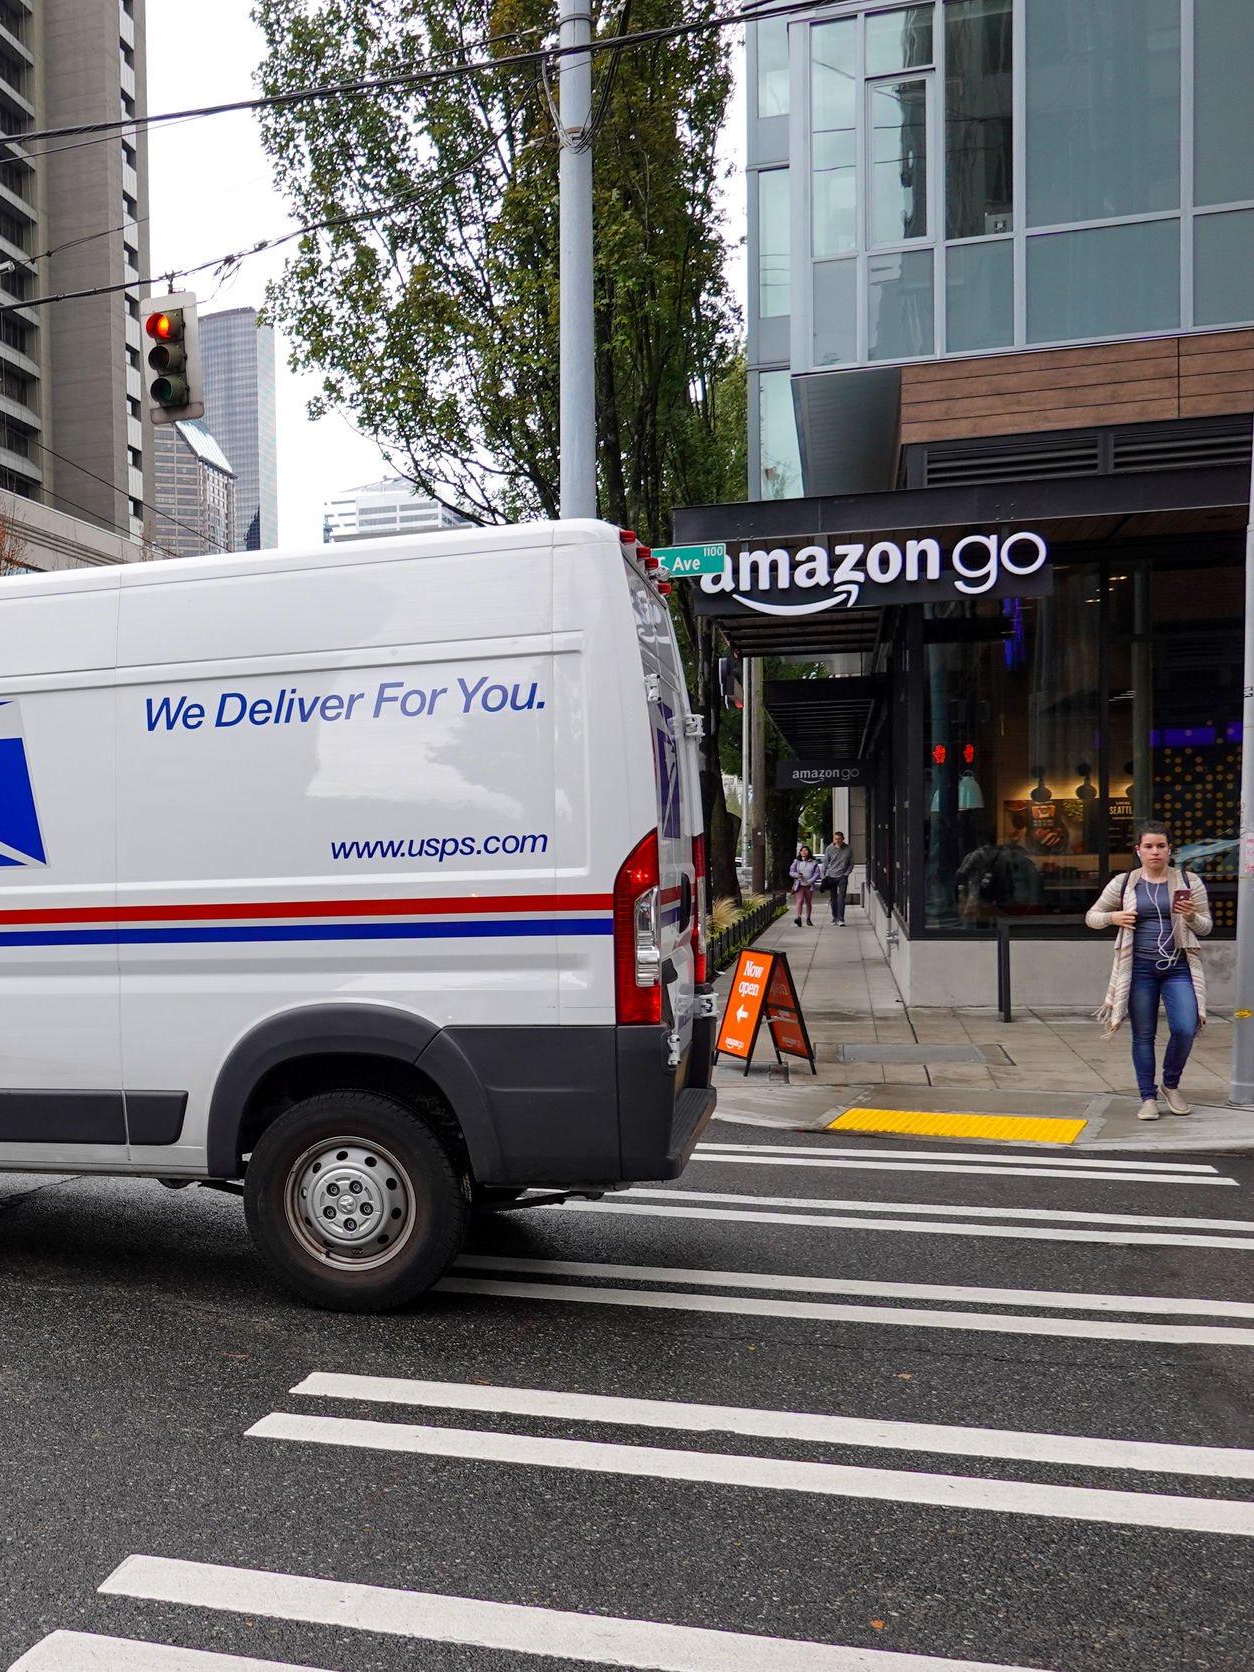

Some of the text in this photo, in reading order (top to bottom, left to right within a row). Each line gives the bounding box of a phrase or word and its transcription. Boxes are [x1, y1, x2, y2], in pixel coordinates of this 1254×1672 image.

[703, 546, 723, 557] 1100
[672, 557, 701, 571] Ave
[700, 531, 1047, 594] amazon go
[145, 676, 546, 732] We Deliver For You.
[792, 768, 859, 780] amazon go
[1109, 805, 1133, 815] SEATTL
[331, 833, 548, 862] www.usps.com
[743, 960, 764, 978] Now
[738, 981, 760, 997] open
